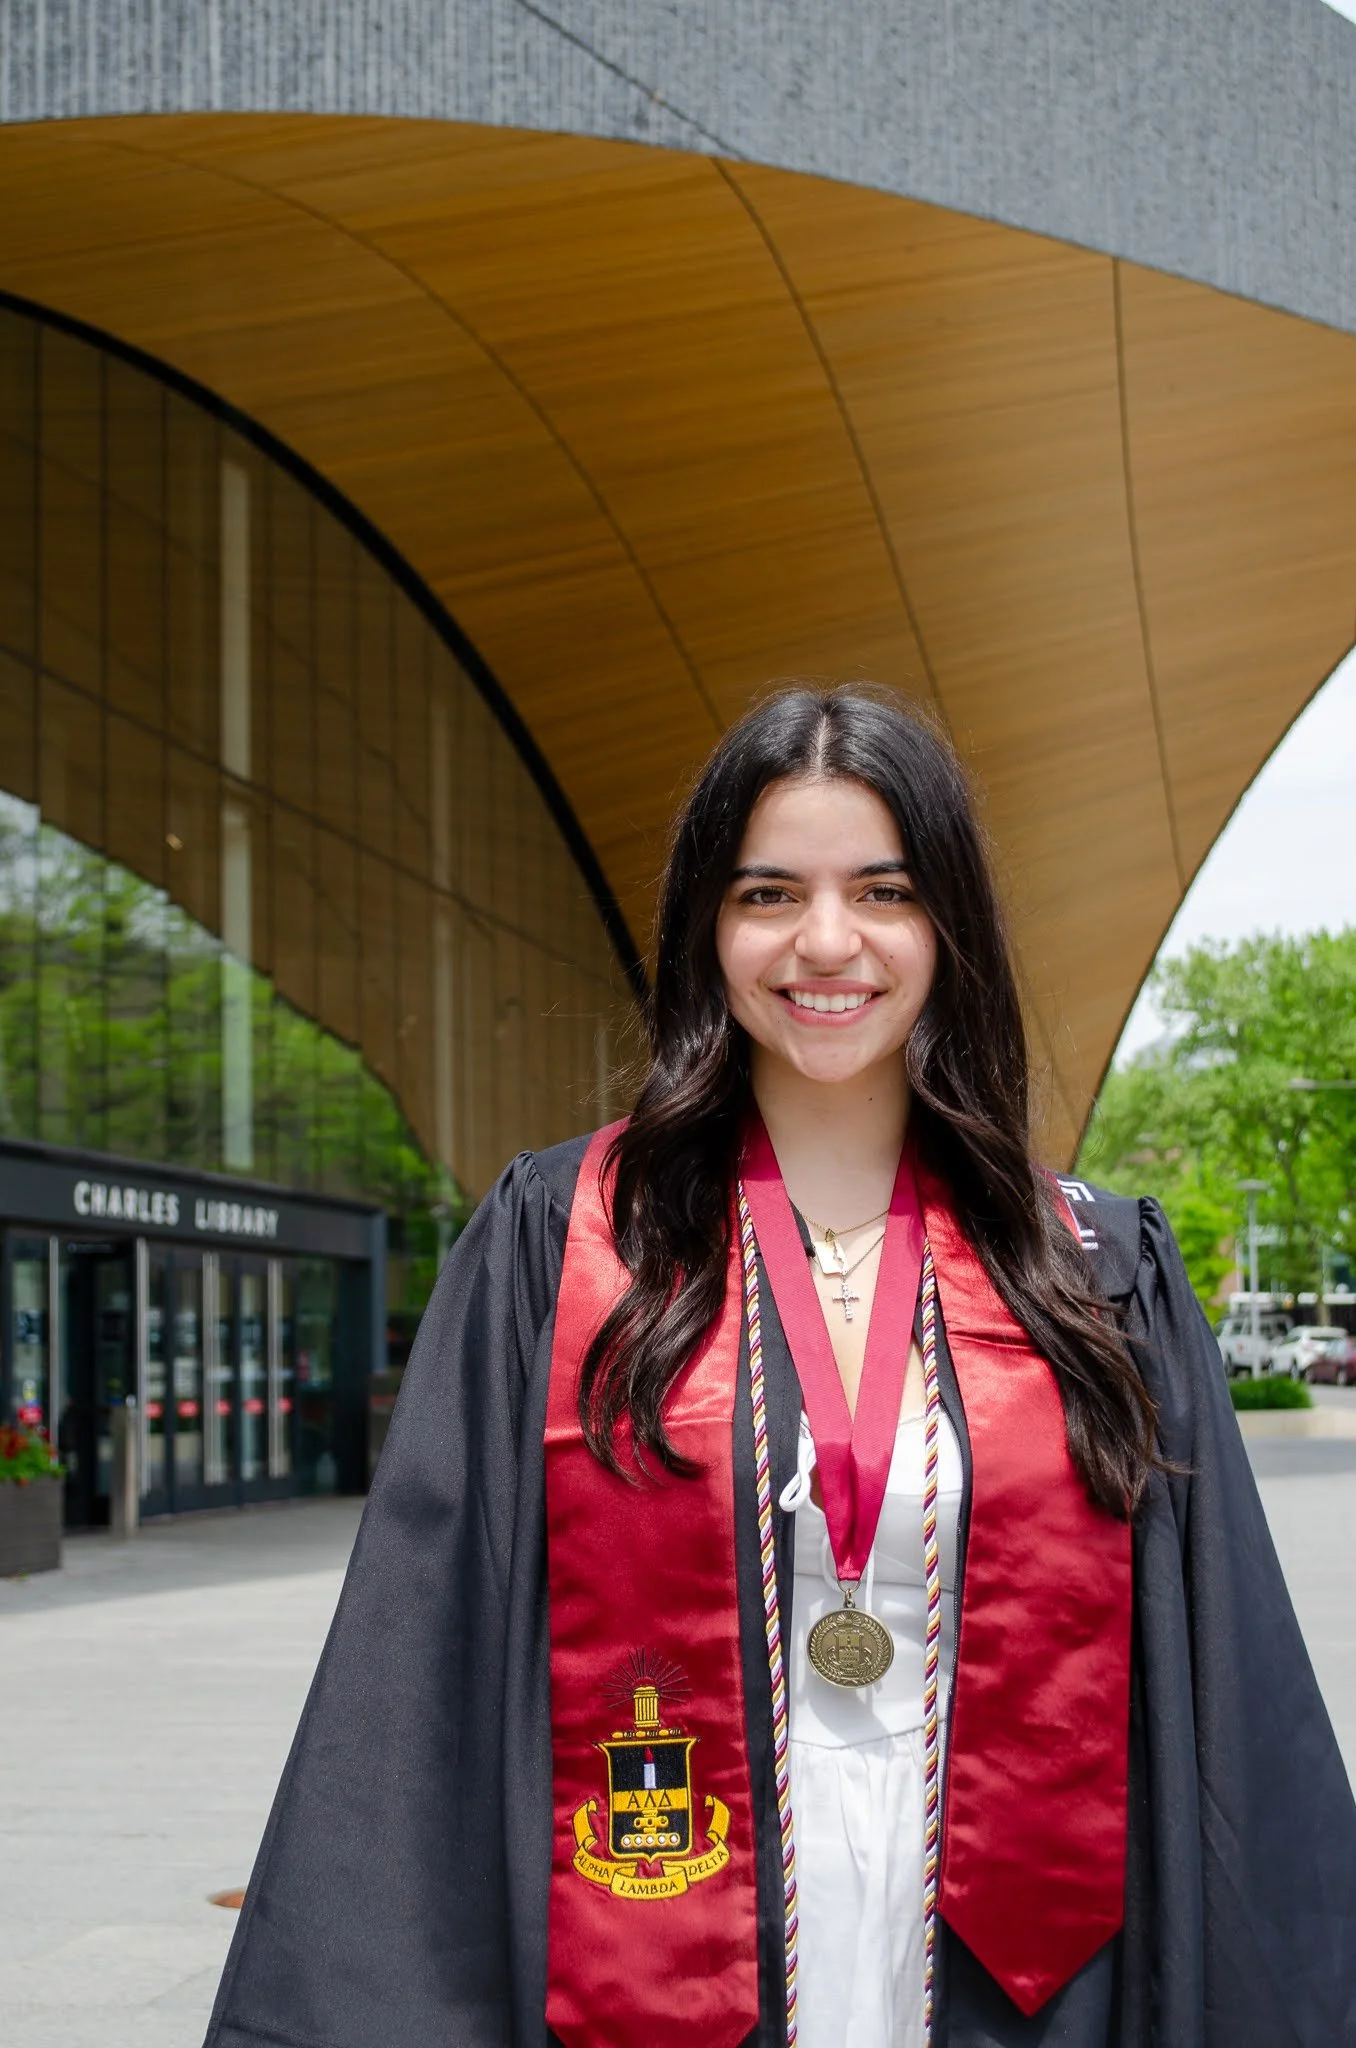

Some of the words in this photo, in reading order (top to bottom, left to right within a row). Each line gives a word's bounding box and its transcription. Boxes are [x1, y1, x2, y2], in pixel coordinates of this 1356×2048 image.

[74, 1180, 179, 1226] CHARLES
[195, 1199, 278, 1238] LIBRARY
[575, 1854, 610, 1877] ALPHA
[620, 1880, 678, 1895] LAMBDA
[689, 1850, 727, 1876] DELTA
